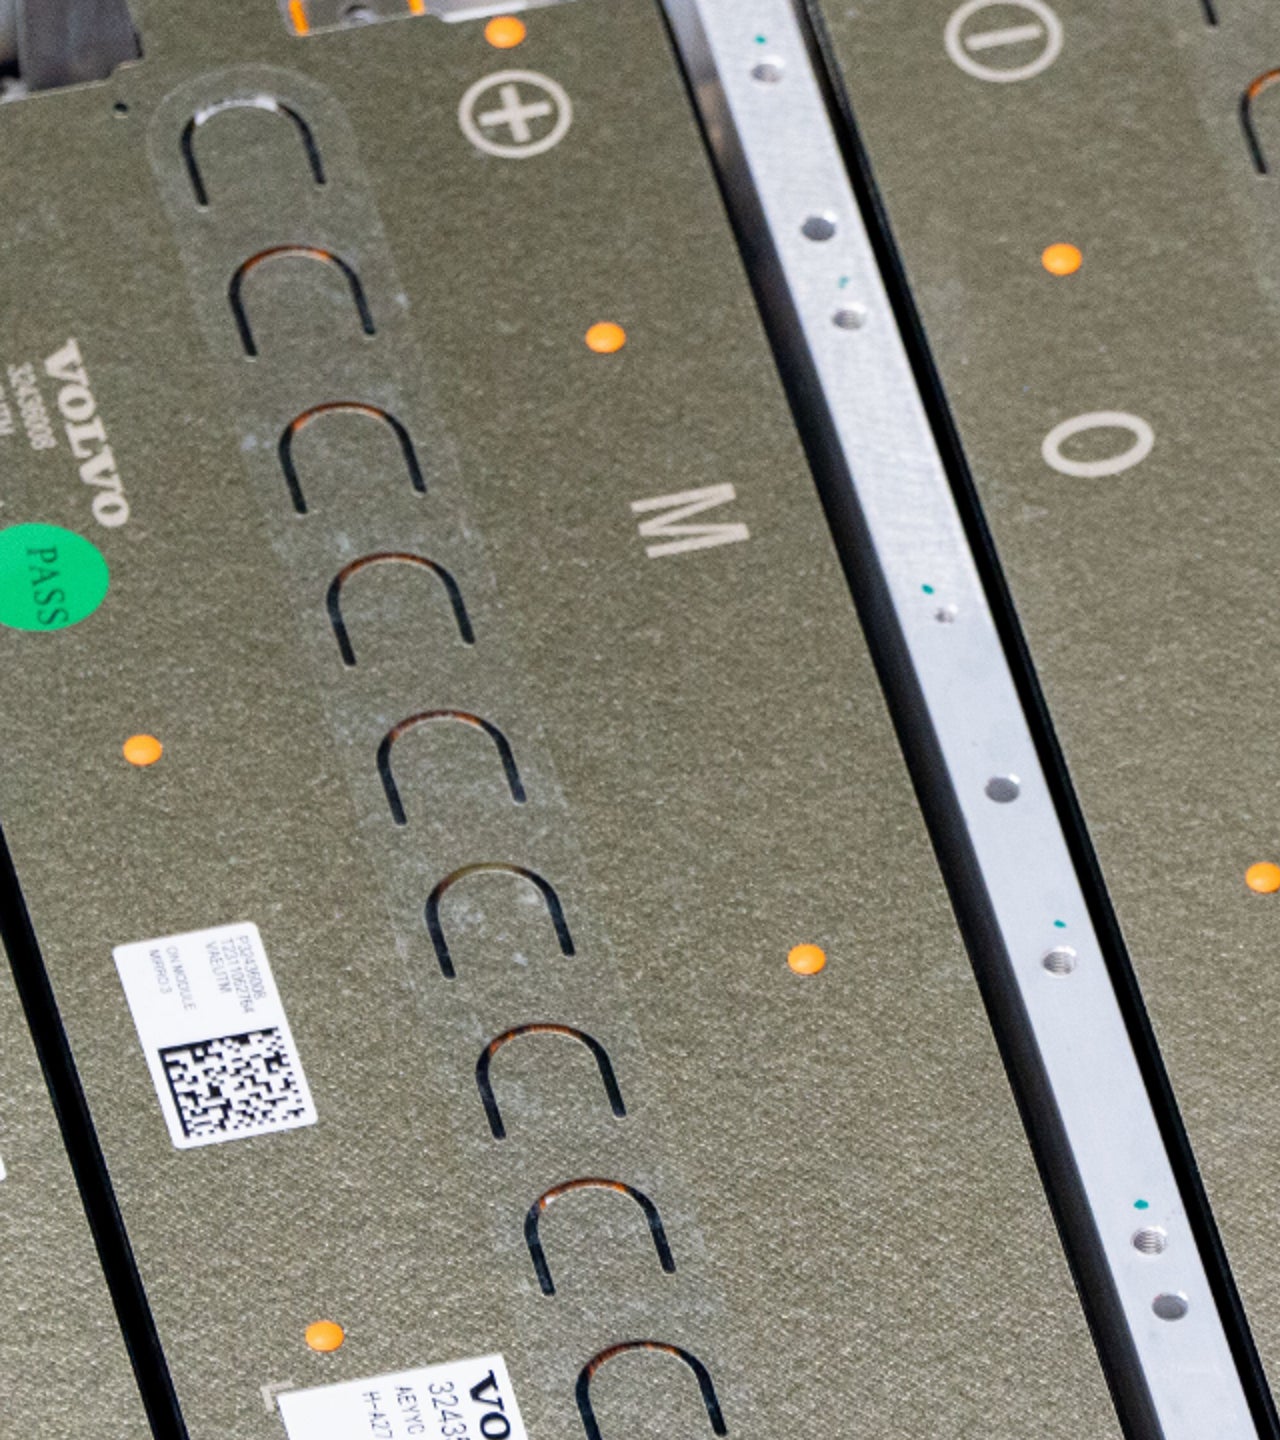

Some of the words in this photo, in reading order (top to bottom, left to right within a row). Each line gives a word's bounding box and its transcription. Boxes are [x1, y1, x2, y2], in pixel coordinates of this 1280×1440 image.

[44, 338, 131, 529] VOLVO
[630, 482, 750, 559] M
[27, 546, 69, 628] PASS
[395, 1387, 425, 1434] AEYYC
